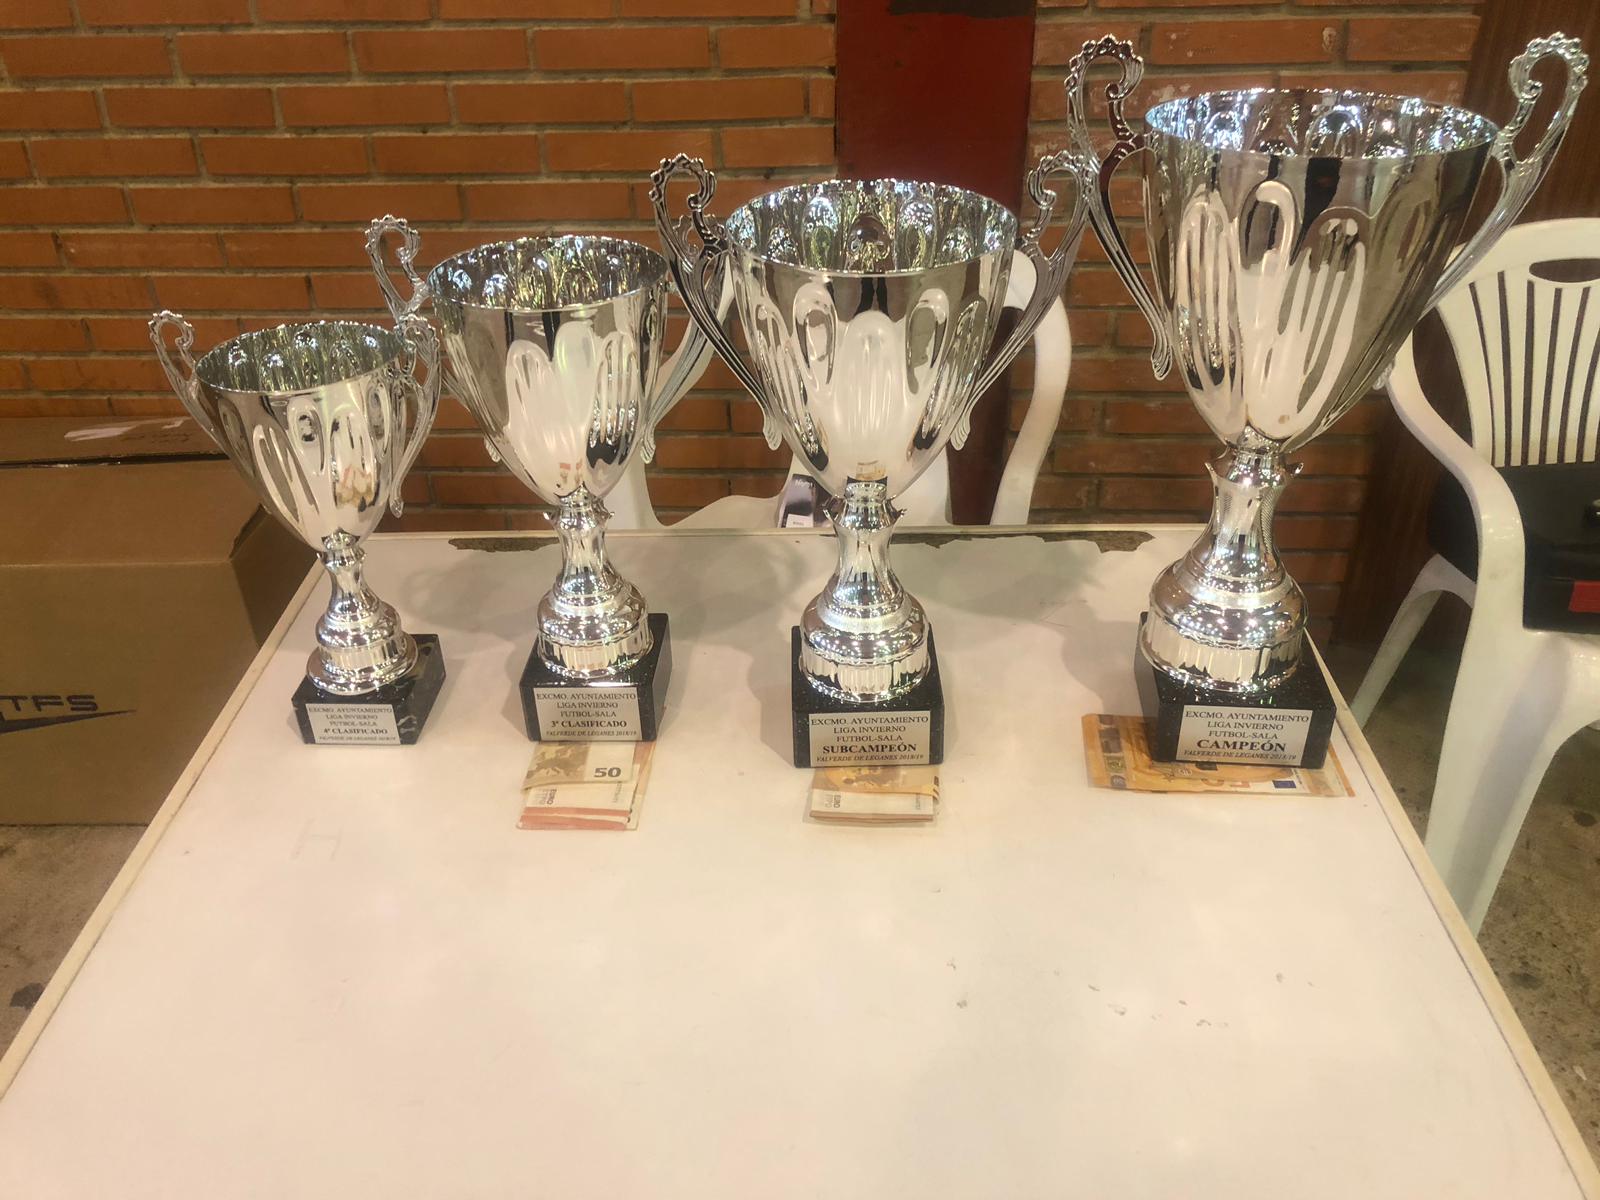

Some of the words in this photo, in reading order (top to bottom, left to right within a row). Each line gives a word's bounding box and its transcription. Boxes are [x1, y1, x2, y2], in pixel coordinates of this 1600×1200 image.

[851, 716, 929, 725] AYUNTAMIENTO
[1227, 712, 1309, 723] AYUNTAMIENTO
[561, 720, 627, 728] CLASIFICADO
[859, 725, 906, 733] INVIERNO
[1207, 721, 1232, 729] LIGA
[1234, 721, 1284, 731] INVIERNO
[837, 735, 903, 743] FUTBOL-SALA
[1208, 730, 1278, 740] FUTBOL-SALA
[823, 742, 917, 754] SUBCAMPEÓN
[1197, 739, 1286, 752] CAMPEÓN
[594, 767, 622, 778] 50
